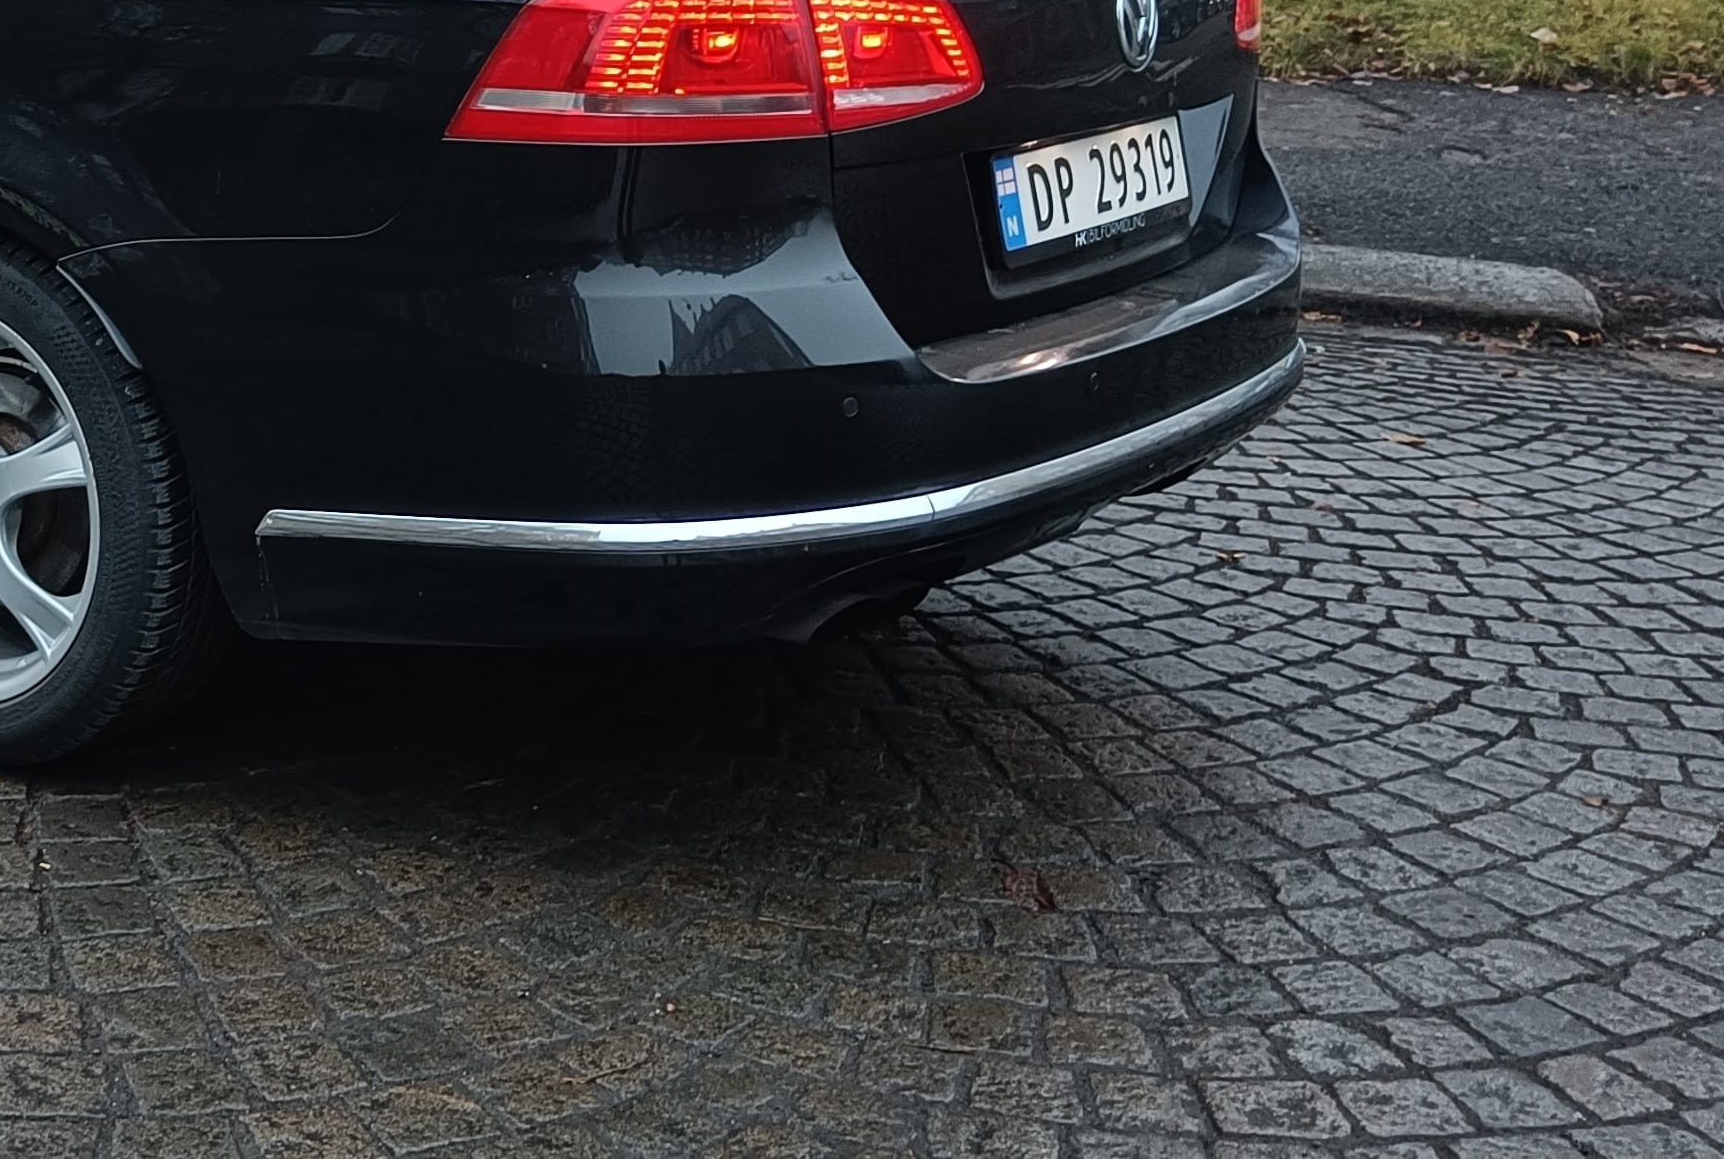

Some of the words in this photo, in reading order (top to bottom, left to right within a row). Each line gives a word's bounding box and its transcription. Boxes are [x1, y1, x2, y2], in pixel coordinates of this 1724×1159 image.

[1027, 156, 1074, 232] DP
[1089, 128, 1176, 215] 29319
[1006, 215, 1020, 238] N
